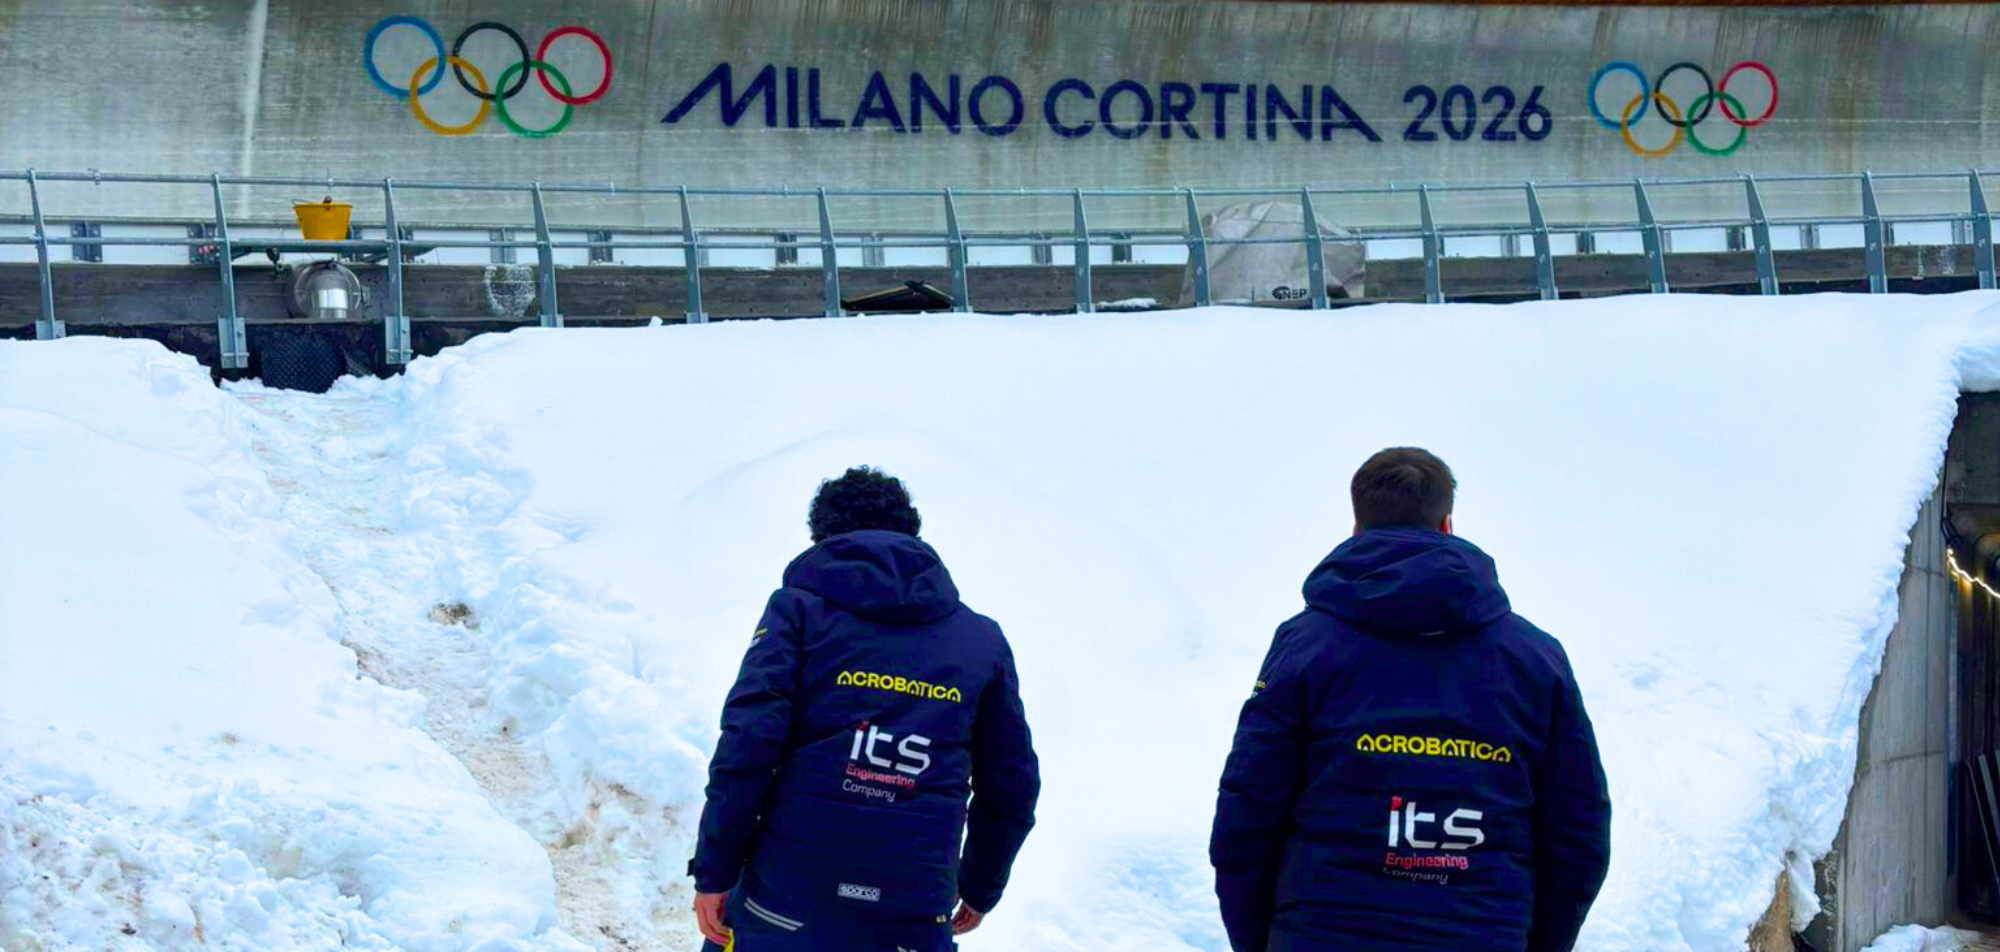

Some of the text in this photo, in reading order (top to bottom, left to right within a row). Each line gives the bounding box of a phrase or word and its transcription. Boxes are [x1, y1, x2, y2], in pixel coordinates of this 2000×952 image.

[660, 62, 1553, 141] MILANO CORTINA 2026
[837, 671, 961, 702] ACROBATICA
[850, 721, 931, 775] its
[1357, 733, 1511, 762] ACROBATICA
[843, 778, 896, 803] Company
[846, 763, 915, 790] Engineering
[1388, 796, 1485, 850] its
[1386, 852, 1469, 870] Engineering
